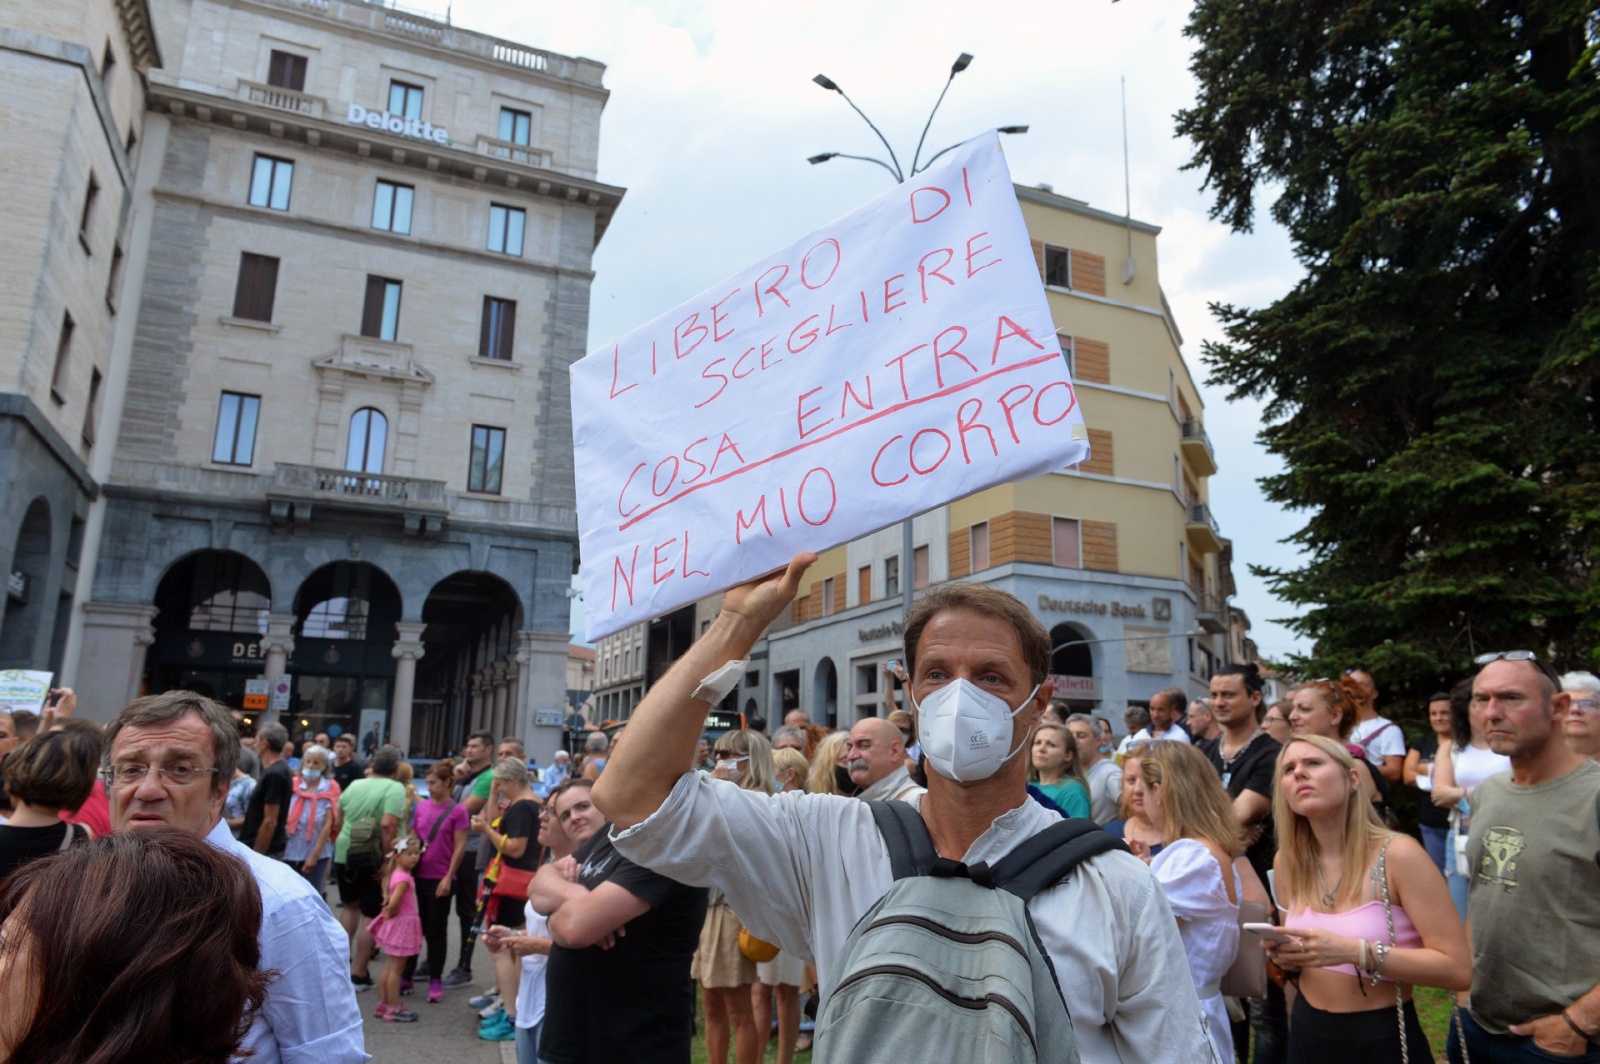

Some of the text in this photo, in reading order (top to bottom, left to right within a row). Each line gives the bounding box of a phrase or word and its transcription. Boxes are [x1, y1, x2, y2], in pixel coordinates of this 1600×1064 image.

[610, 166, 973, 399] LIBERO DI
[694, 231, 1002, 409] SCEGLIERE
[611, 381, 1076, 611] NEL MIO CORPO
[618, 315, 1044, 518] COSA ENTRA
[1038, 595, 1146, 618] Deutsche Bank
